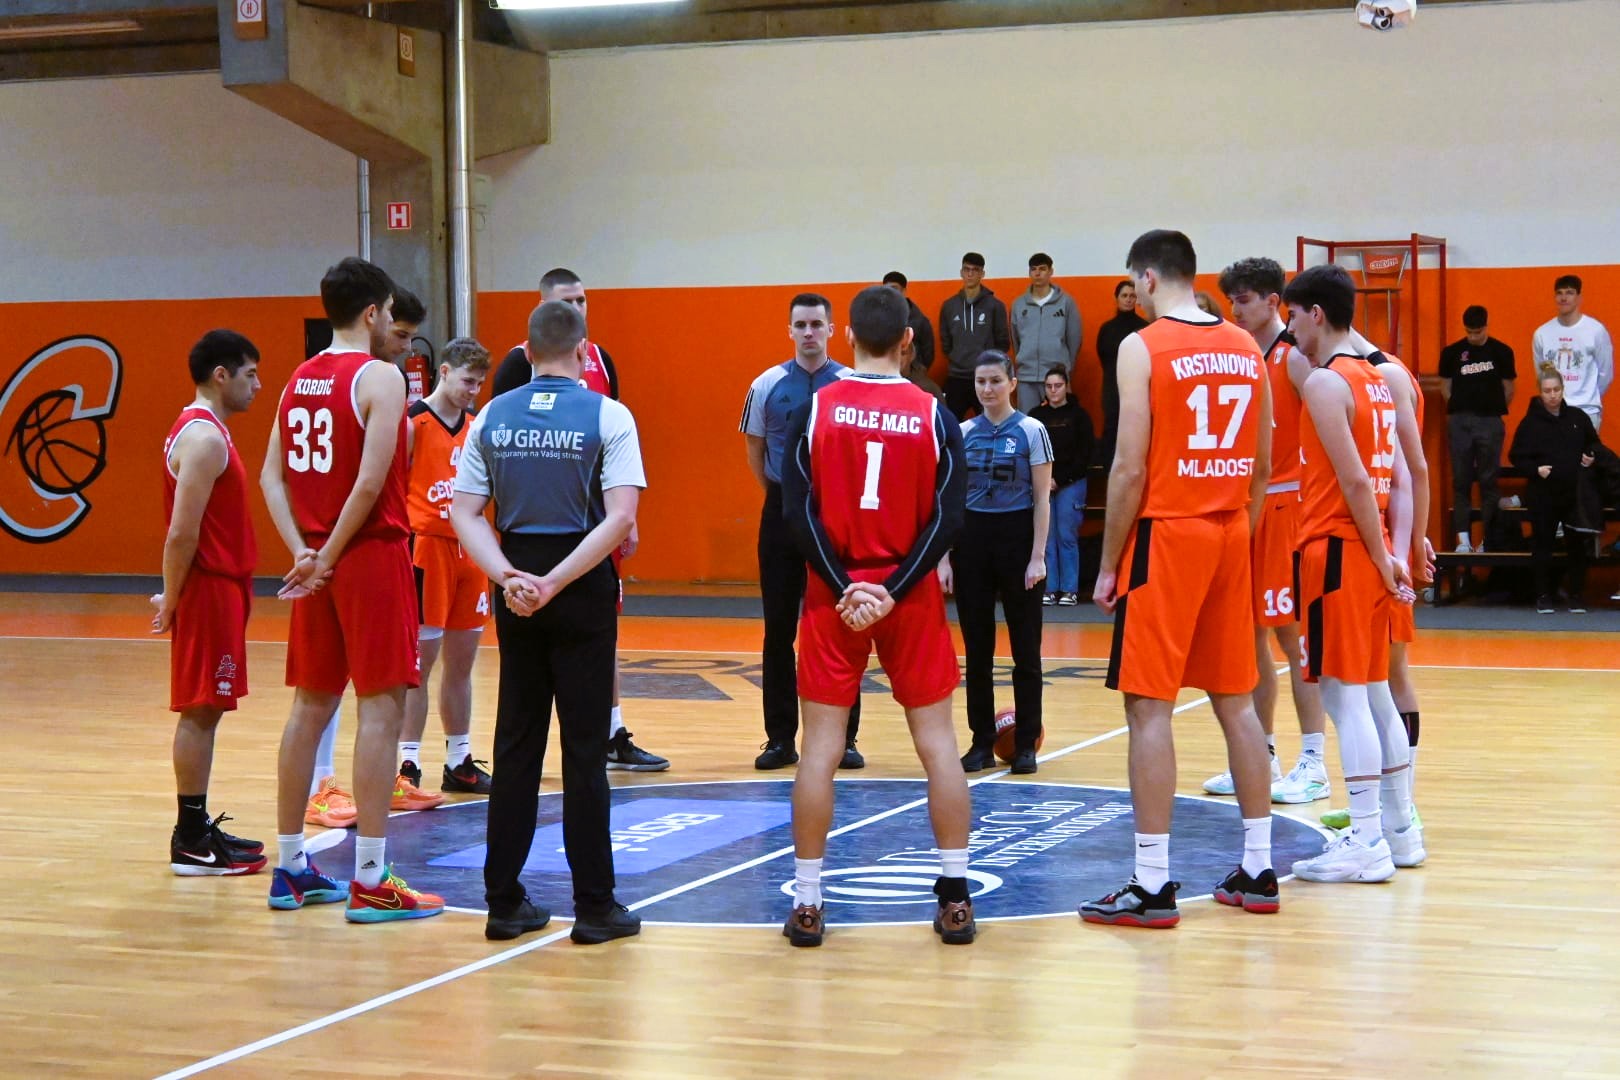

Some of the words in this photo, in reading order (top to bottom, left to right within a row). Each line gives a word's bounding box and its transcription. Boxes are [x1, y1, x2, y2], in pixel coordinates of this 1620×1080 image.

[390, 205, 408, 228] H
[1170, 352, 1259, 381] KRSTANOVIĆ
[293, 374, 335, 396] KORDIĆ
[1186, 384, 1252, 450] 17
[287, 407, 333, 474] 33
[514, 429, 585, 451] GRAWE
[859, 440, 884, 510] 1
[1177, 458, 1255, 477] MLADOST
[475, 591, 489, 616] 4
[1263, 587, 1294, 617] 16
